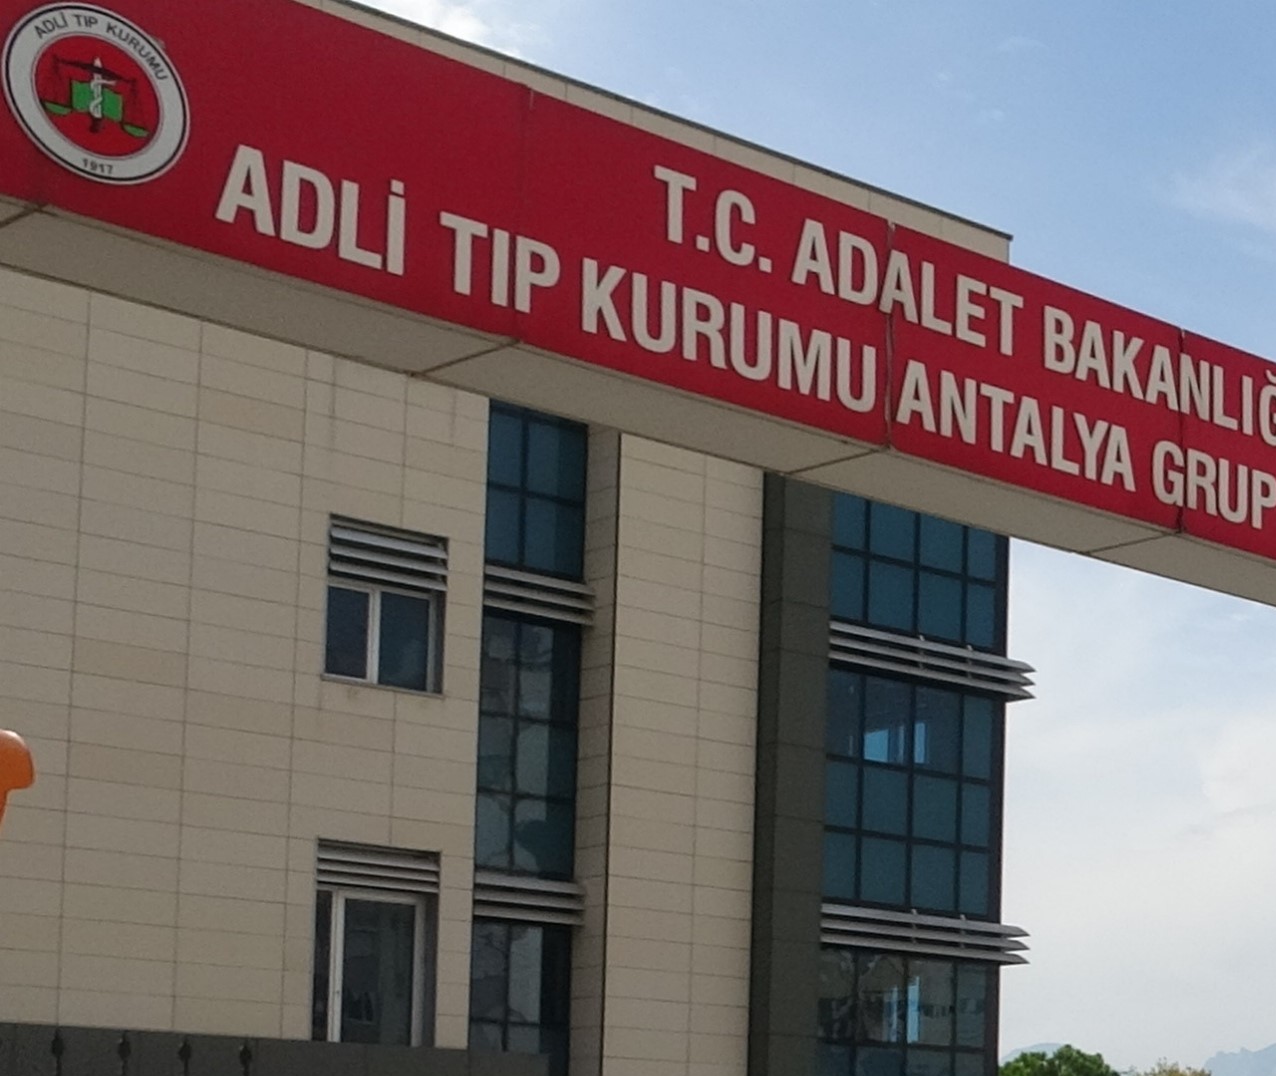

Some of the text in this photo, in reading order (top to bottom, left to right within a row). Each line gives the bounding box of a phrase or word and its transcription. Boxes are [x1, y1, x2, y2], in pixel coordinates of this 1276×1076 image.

[34, 12, 169, 81] ADLİ TIP KURUMU
[82, 158, 113, 174] 1917
[215, 144, 406, 276] ADLİ
[440, 212, 561, 314] TIP
[582, 258, 877, 413] KURUMU
[896, 359, 1136, 492] ANTALYA
[654, 165, 772, 273] T.C.
[791, 218, 1024, 356] ADALET
